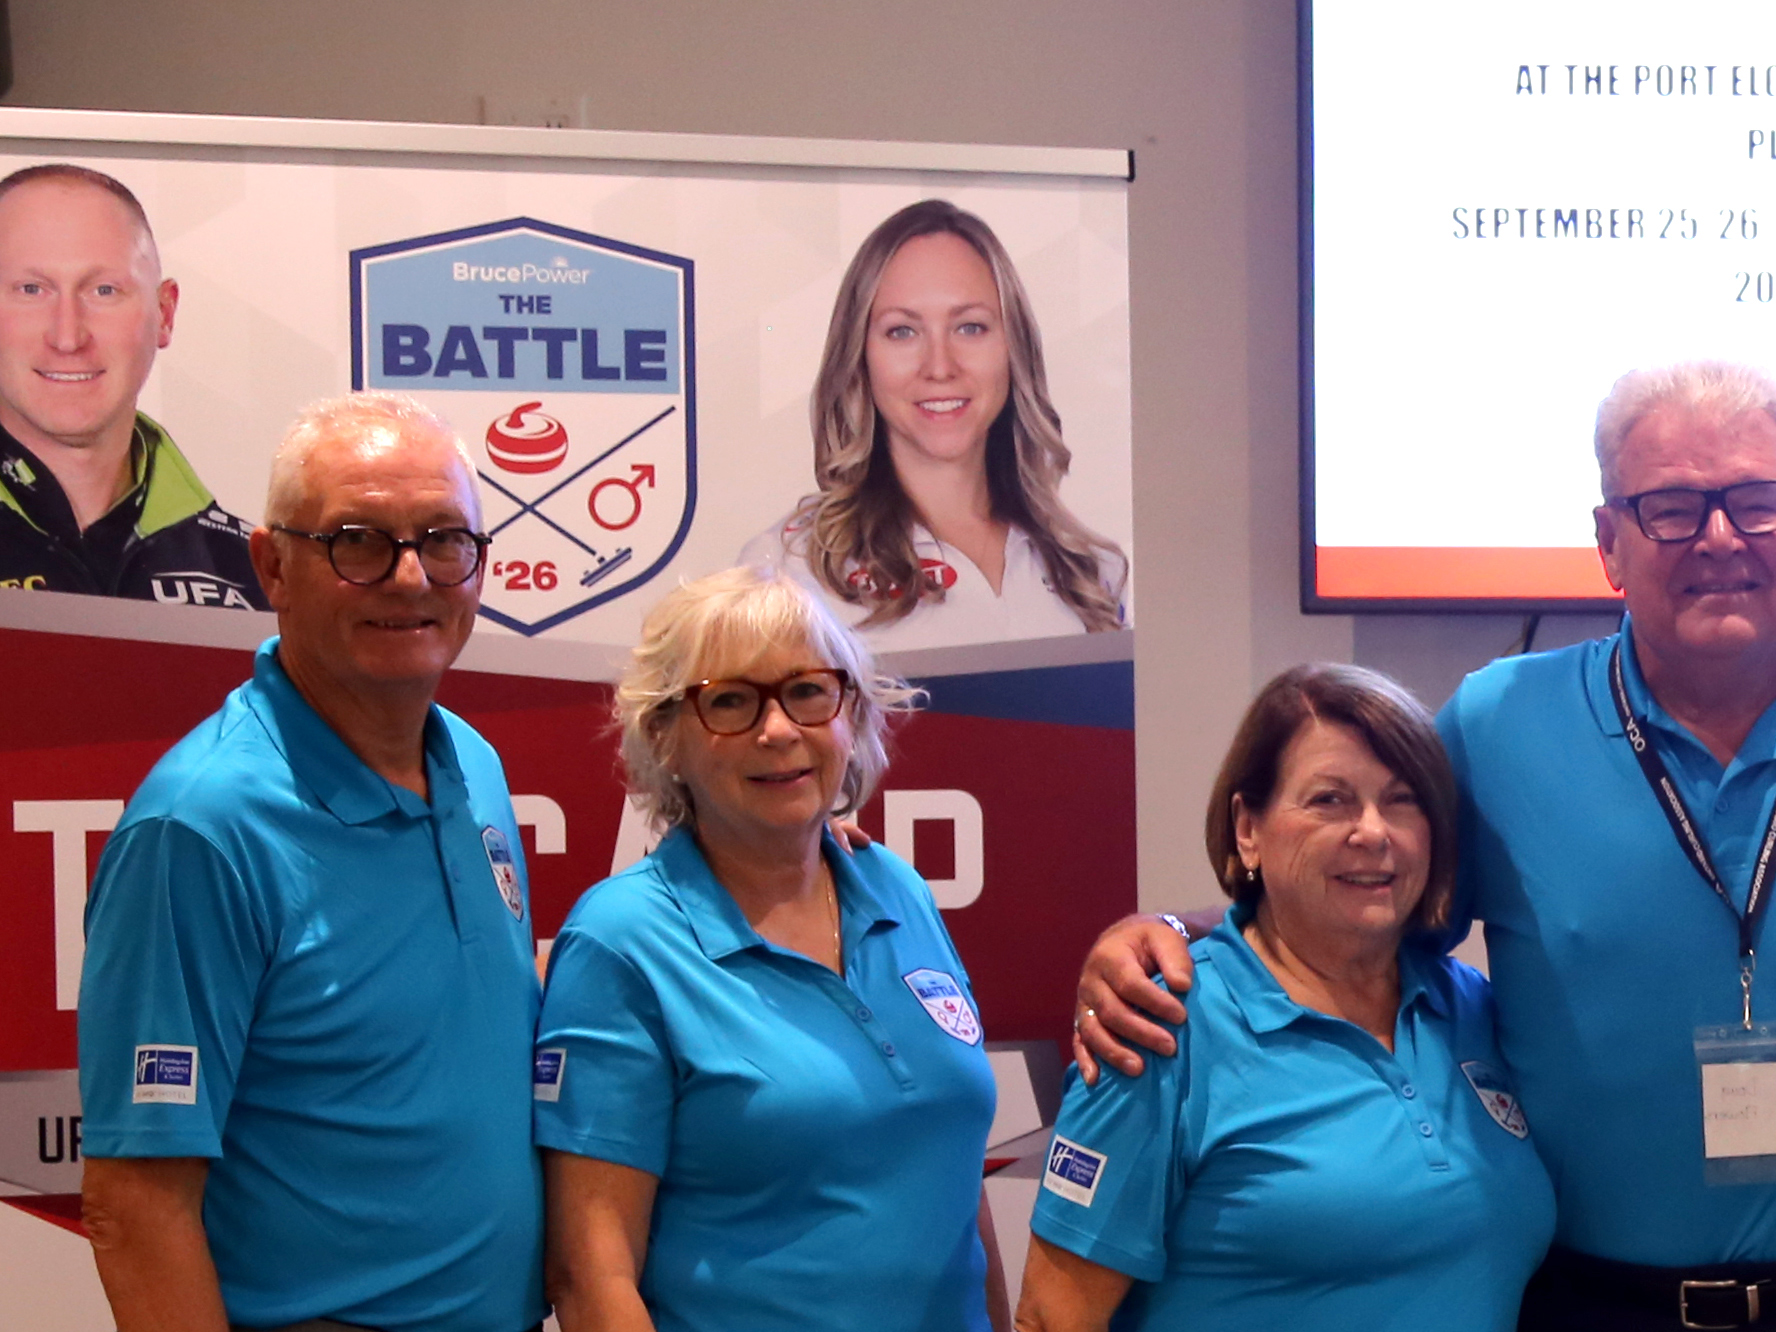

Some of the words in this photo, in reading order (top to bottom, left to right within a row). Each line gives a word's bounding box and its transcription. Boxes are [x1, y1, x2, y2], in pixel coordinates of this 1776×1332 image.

[1516, 65, 1551, 96] AT
[1565, 65, 1621, 96] THE
[1634, 65, 1718, 96] PORT
[1452, 207, 1645, 239] SEPTEMBER
[1658, 208, 1698, 239] 25
[1719, 208, 1758, 239] 26
[499, 294, 552, 315] THE
[382, 324, 668, 382] BATTLE
[151, 578, 256, 611] UFA
